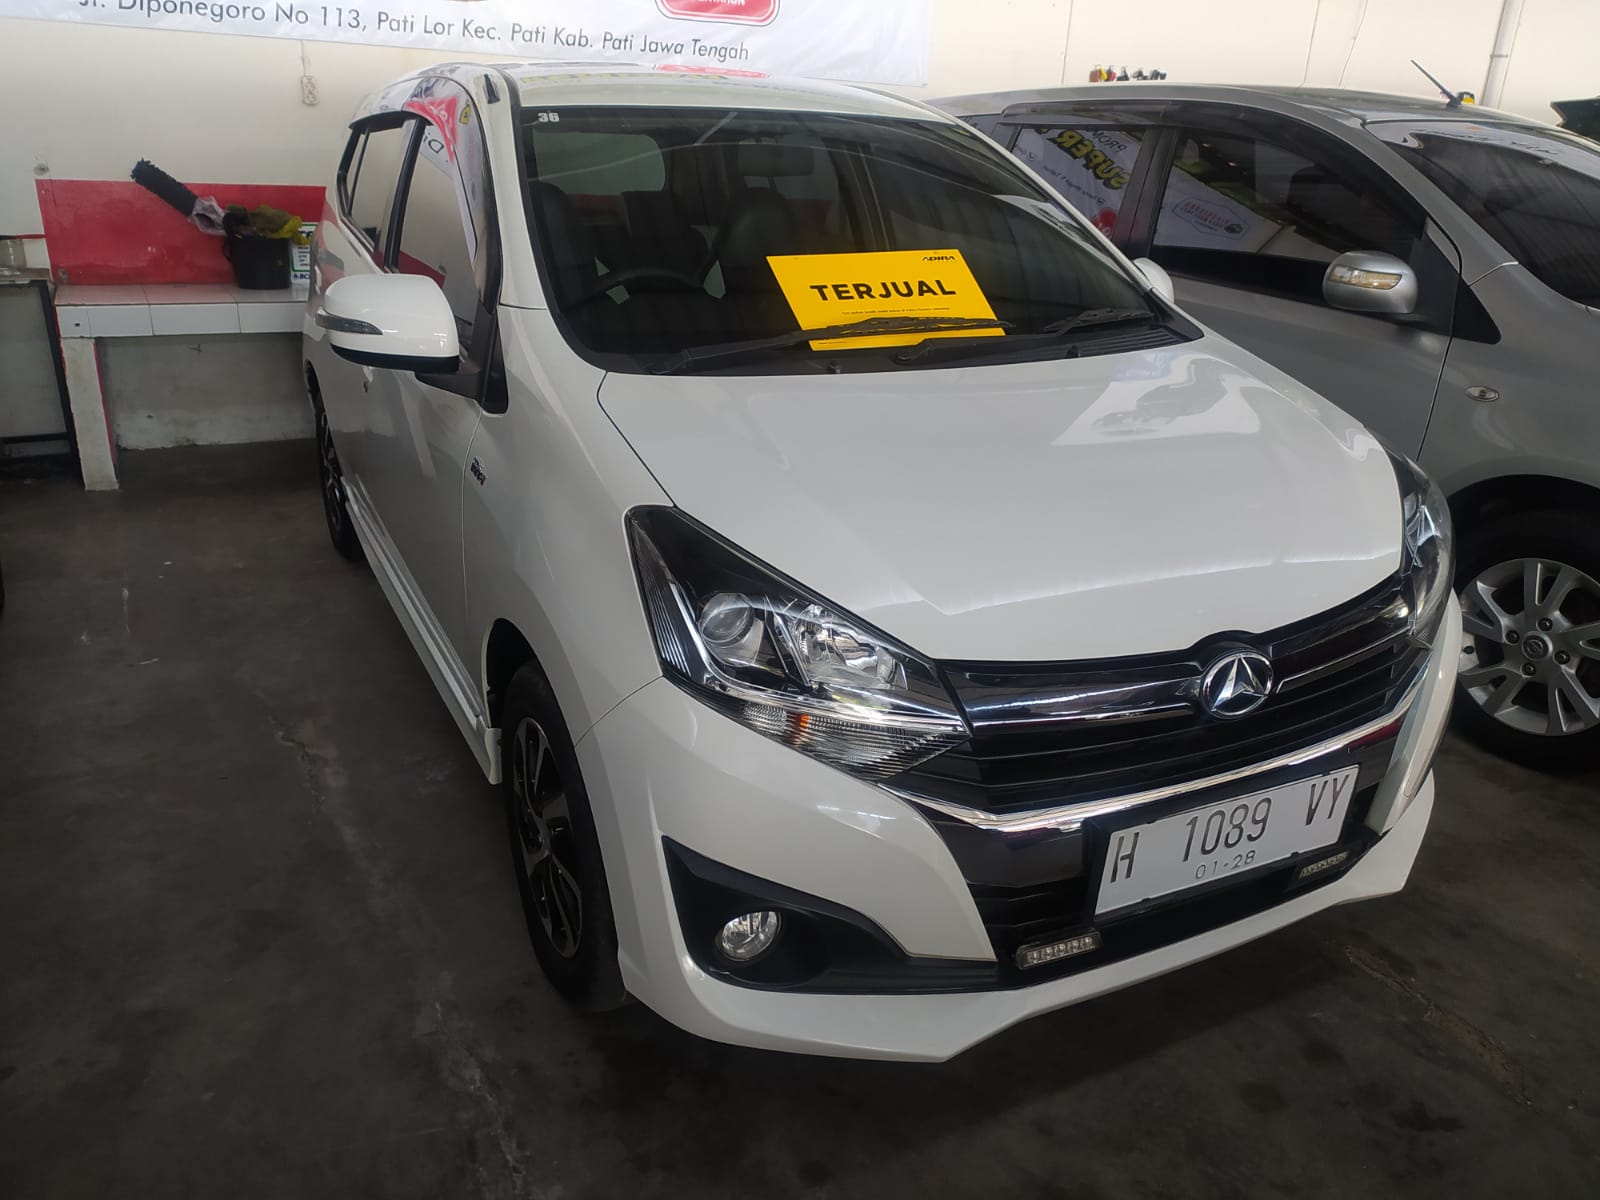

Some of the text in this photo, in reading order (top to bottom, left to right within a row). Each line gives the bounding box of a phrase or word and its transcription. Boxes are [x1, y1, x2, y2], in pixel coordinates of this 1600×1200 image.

[118, 0, 749, 63] Diponegoro No 113, Pati Lor Kec. Pati Kab. Pati Jawa Tengah
[537, 112, 560, 122] 36
[810, 279, 956, 301] TERJUAL
[1110, 774, 1350, 883] H 1089 VY
[1195, 849, 1256, 880] 01-28
